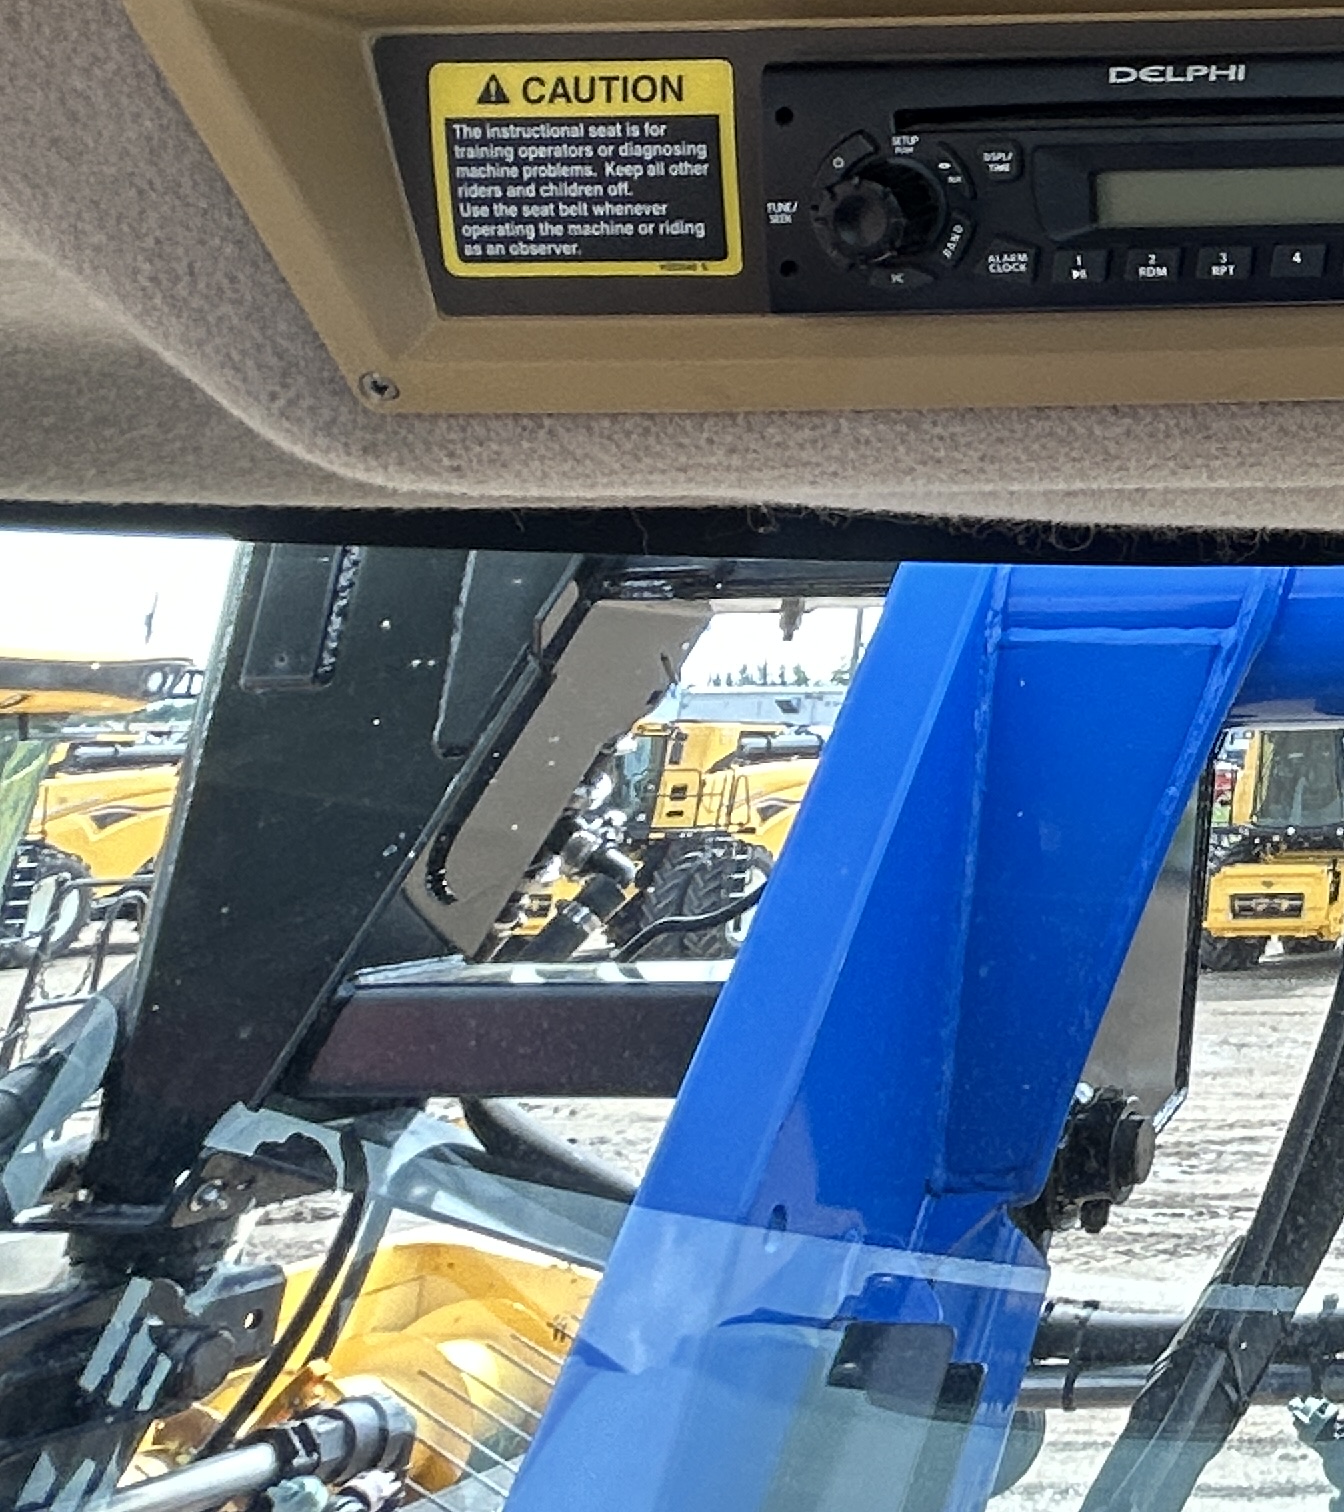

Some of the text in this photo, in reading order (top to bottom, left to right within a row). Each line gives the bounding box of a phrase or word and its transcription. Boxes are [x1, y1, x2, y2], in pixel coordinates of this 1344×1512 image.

[1109, 65, 1246, 84] DELPHI
[522, 75, 684, 104] CAUTION
[453, 123, 667, 139] The instructional seat is for
[455, 142, 707, 161] training operators or diagnosing
[456, 161, 709, 181] machine problems. Keep all other
[458, 182, 633, 198] riders and children off.
[943, 224, 964, 259] BAND
[988, 253, 1028, 263] ALARM
[1148, 254, 1156, 264] 2
[1219, 253, 1227, 263] 3
[1292, 252, 1301, 263] 4
[989, 262, 1027, 274] CLOCK
[1212, 264, 1235, 276] RPT
